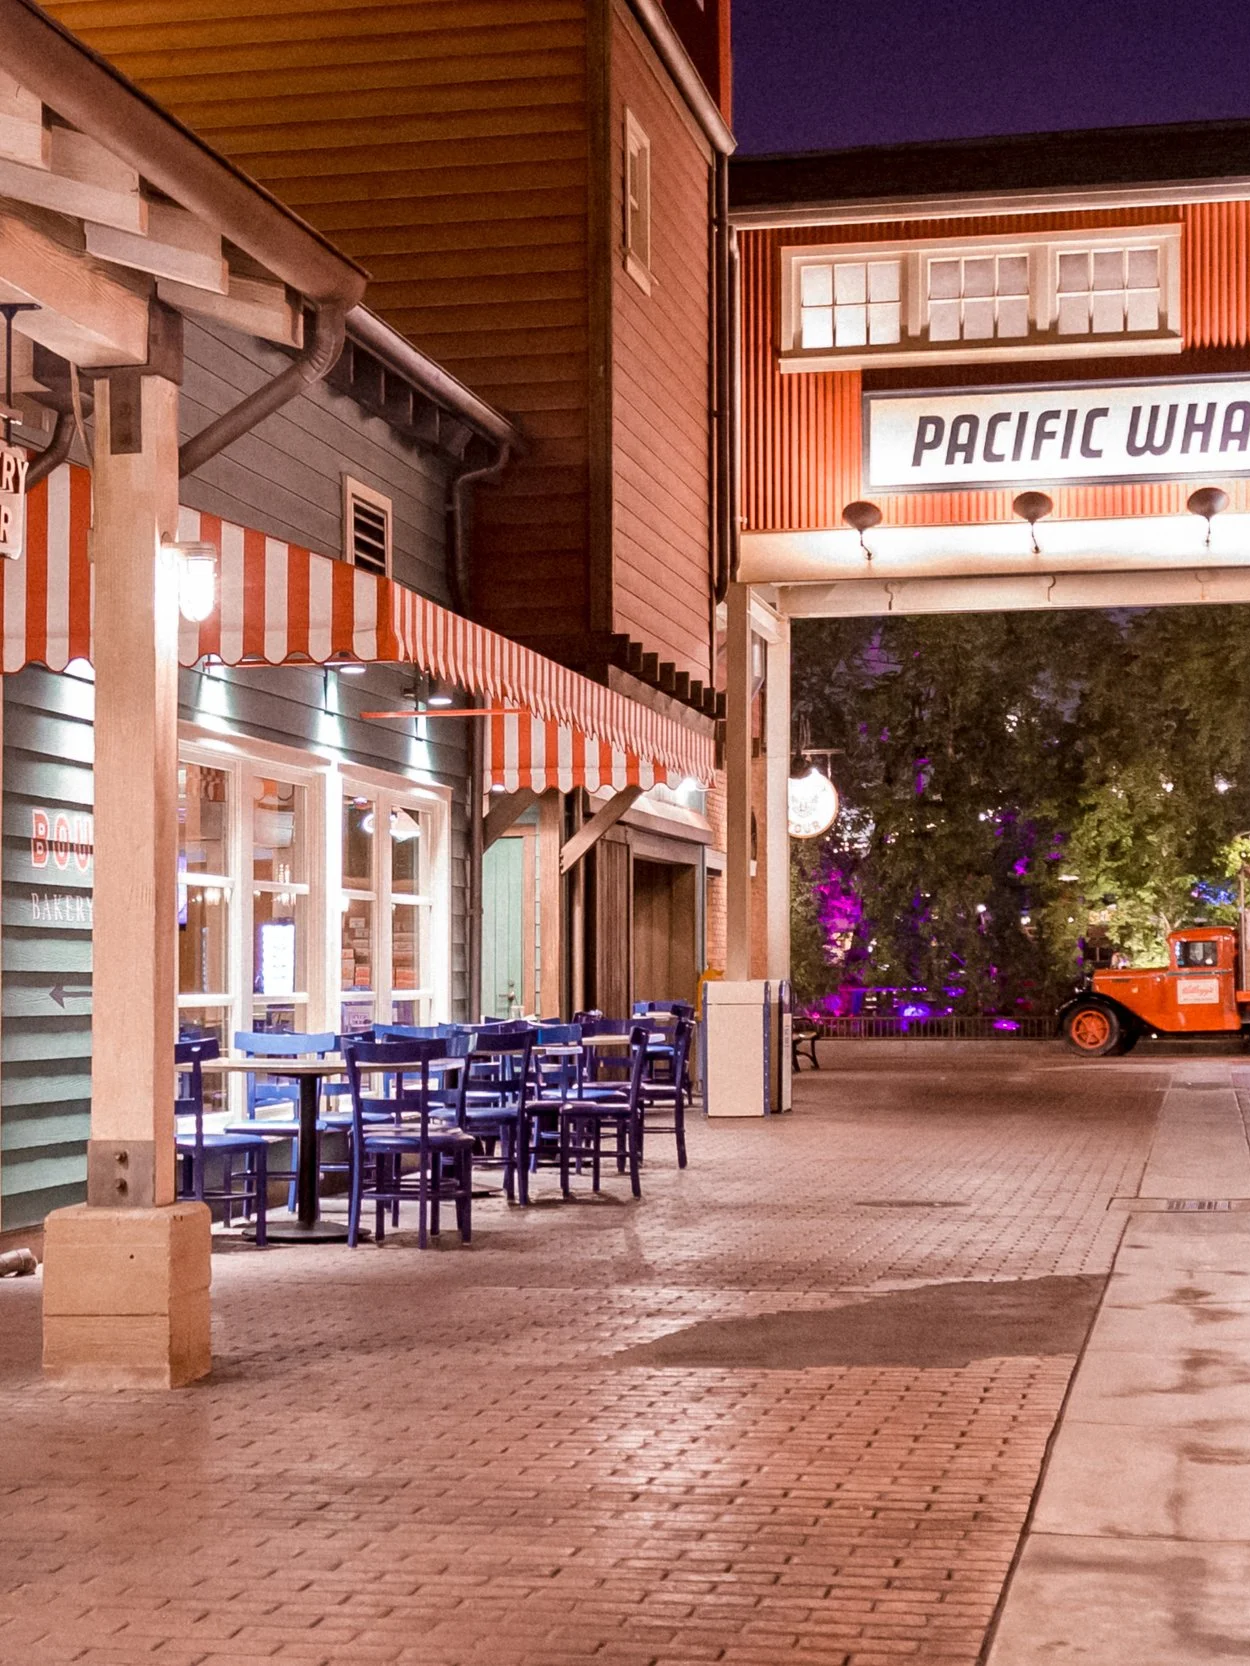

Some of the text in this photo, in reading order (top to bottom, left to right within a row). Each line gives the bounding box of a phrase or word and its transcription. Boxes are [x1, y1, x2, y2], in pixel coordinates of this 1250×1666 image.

[912, 407, 1110, 467] PACIFIC
[0, 451, 28, 494] RY
[31, 892, 93, 922] BAKERY
